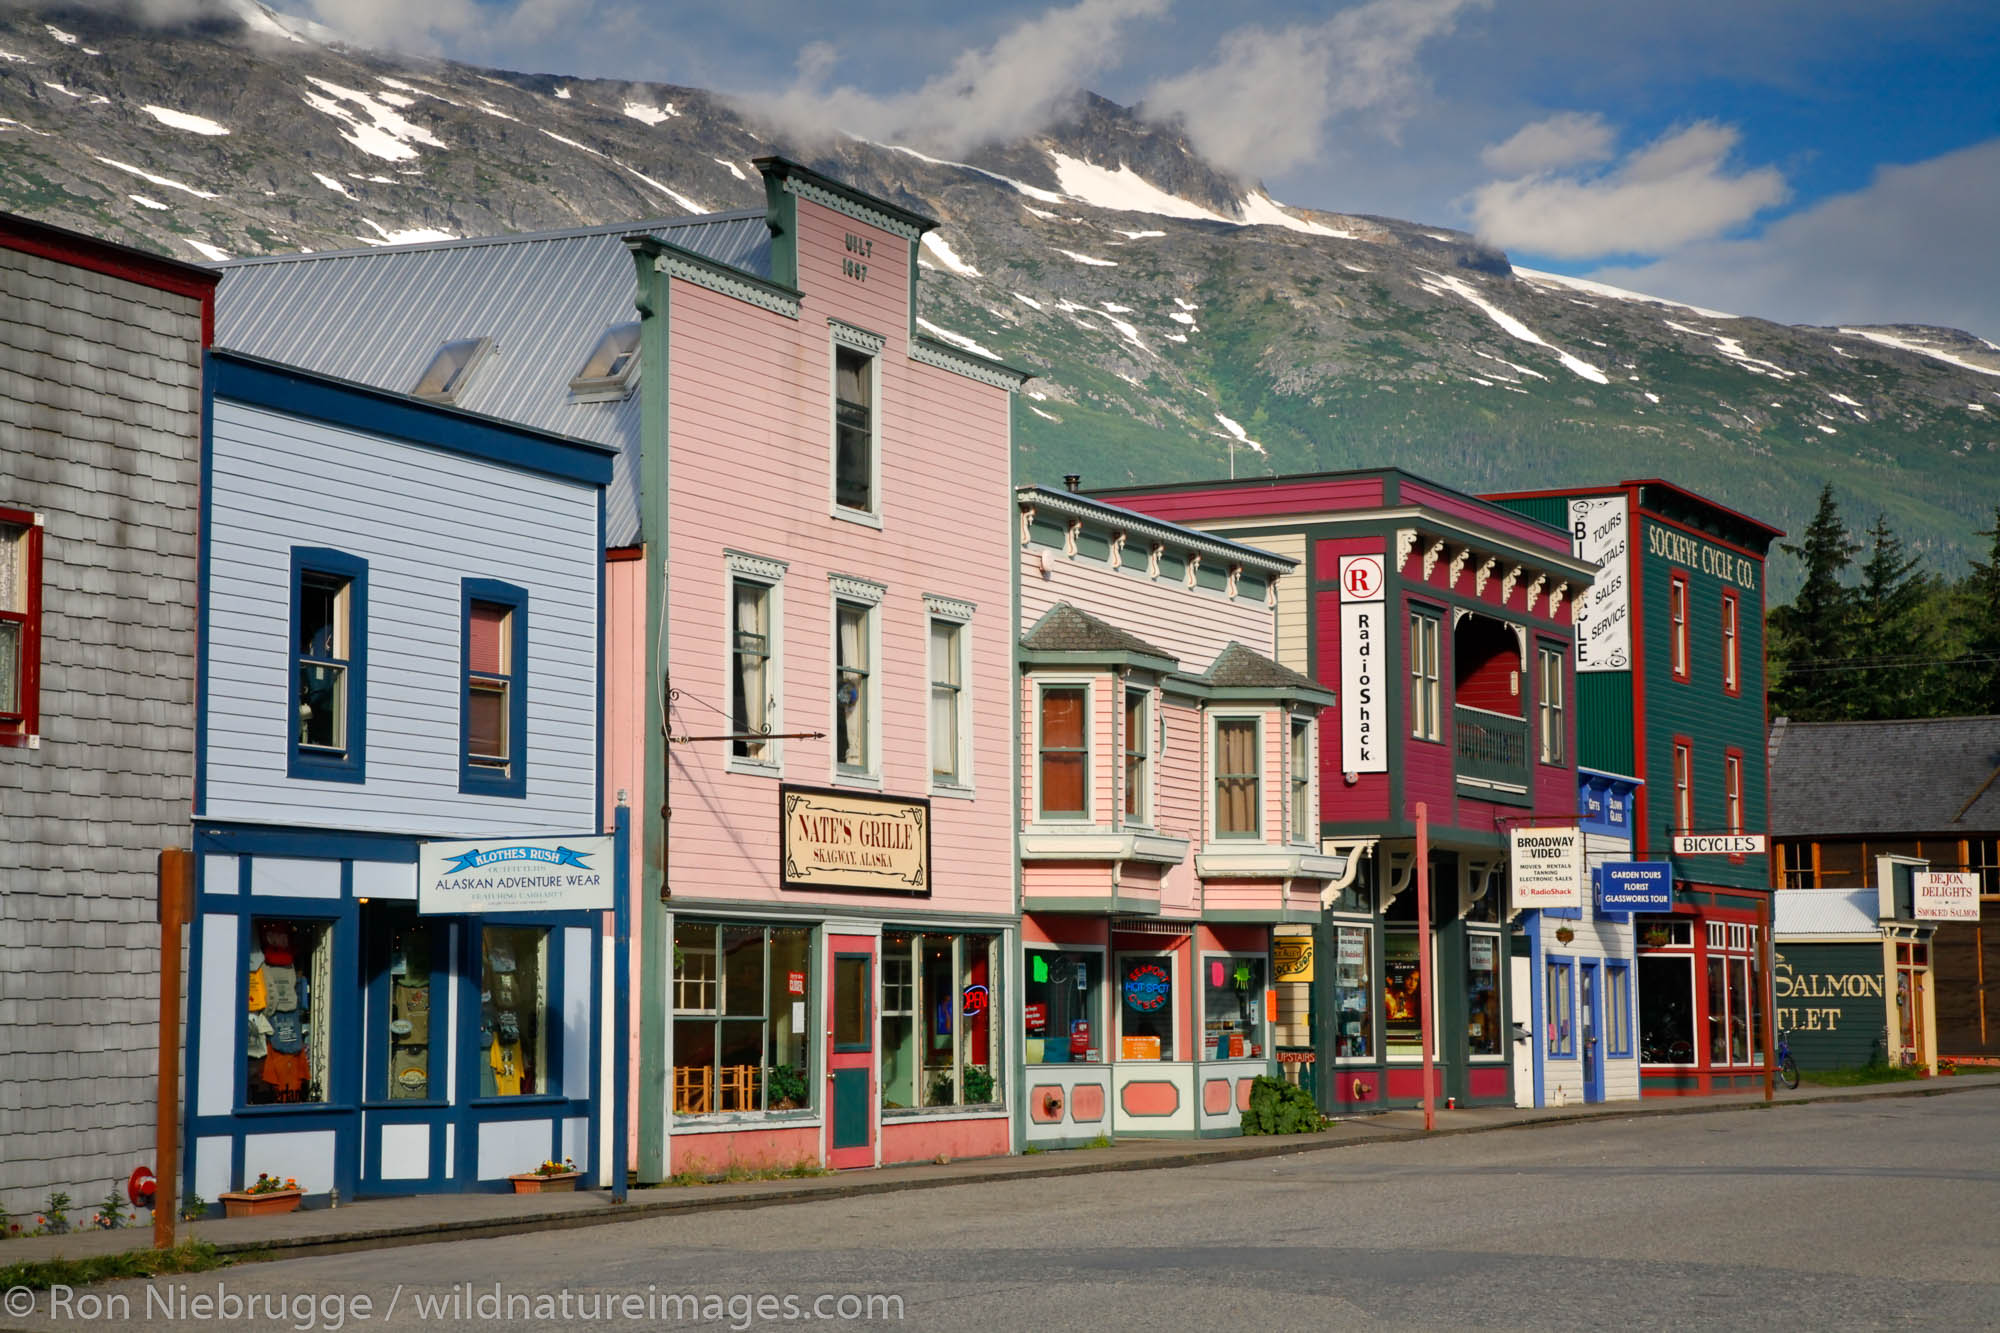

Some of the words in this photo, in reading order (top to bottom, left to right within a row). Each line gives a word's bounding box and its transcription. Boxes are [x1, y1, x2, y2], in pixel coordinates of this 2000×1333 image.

[1593, 512, 1622, 543] TOURS
[1649, 524, 1698, 569] SOCKEYE
[1702, 545, 1733, 581] CYCLE
[1736, 558, 1755, 590] CO.
[1595, 575, 1622, 605] SALES
[1591, 604, 1626, 640] SERVICE
[1358, 614, 1371, 761] RadioShack
[1609, 810, 1623, 822] GLASS
[798, 814, 852, 845] NATE'S
[859, 819, 913, 851] GRILLE
[1517, 836, 1574, 848] BROADWAY
[1683, 837, 1756, 852] BICYCLES
[475, 849, 527, 867] KLOTHES
[530, 849, 560, 863] RUSH
[859, 851, 893, 868] ALASKA
[1530, 848, 1561, 858] VIDEO
[435, 878, 493, 891] ALASKAN
[496, 875, 562, 888] ADVENTURE
[566, 874, 600, 886] WEAR
[1611, 871, 1639, 879] GARDEN
[1640, 871, 1661, 879] TOURS
[1624, 882, 1649, 891] FLORIST
[1922, 886, 1973, 897] DELIGHTS
[1605, 894, 1649, 903] GLASSWORKS
[1650, 895, 1668, 903] TOUR
[1125, 982, 1144, 993] HOT
[1145, 983, 1170, 993] SPOT
[1775, 963, 1884, 997] SALMON
[1276, 1051, 1316, 1063] UPSTAIRS
